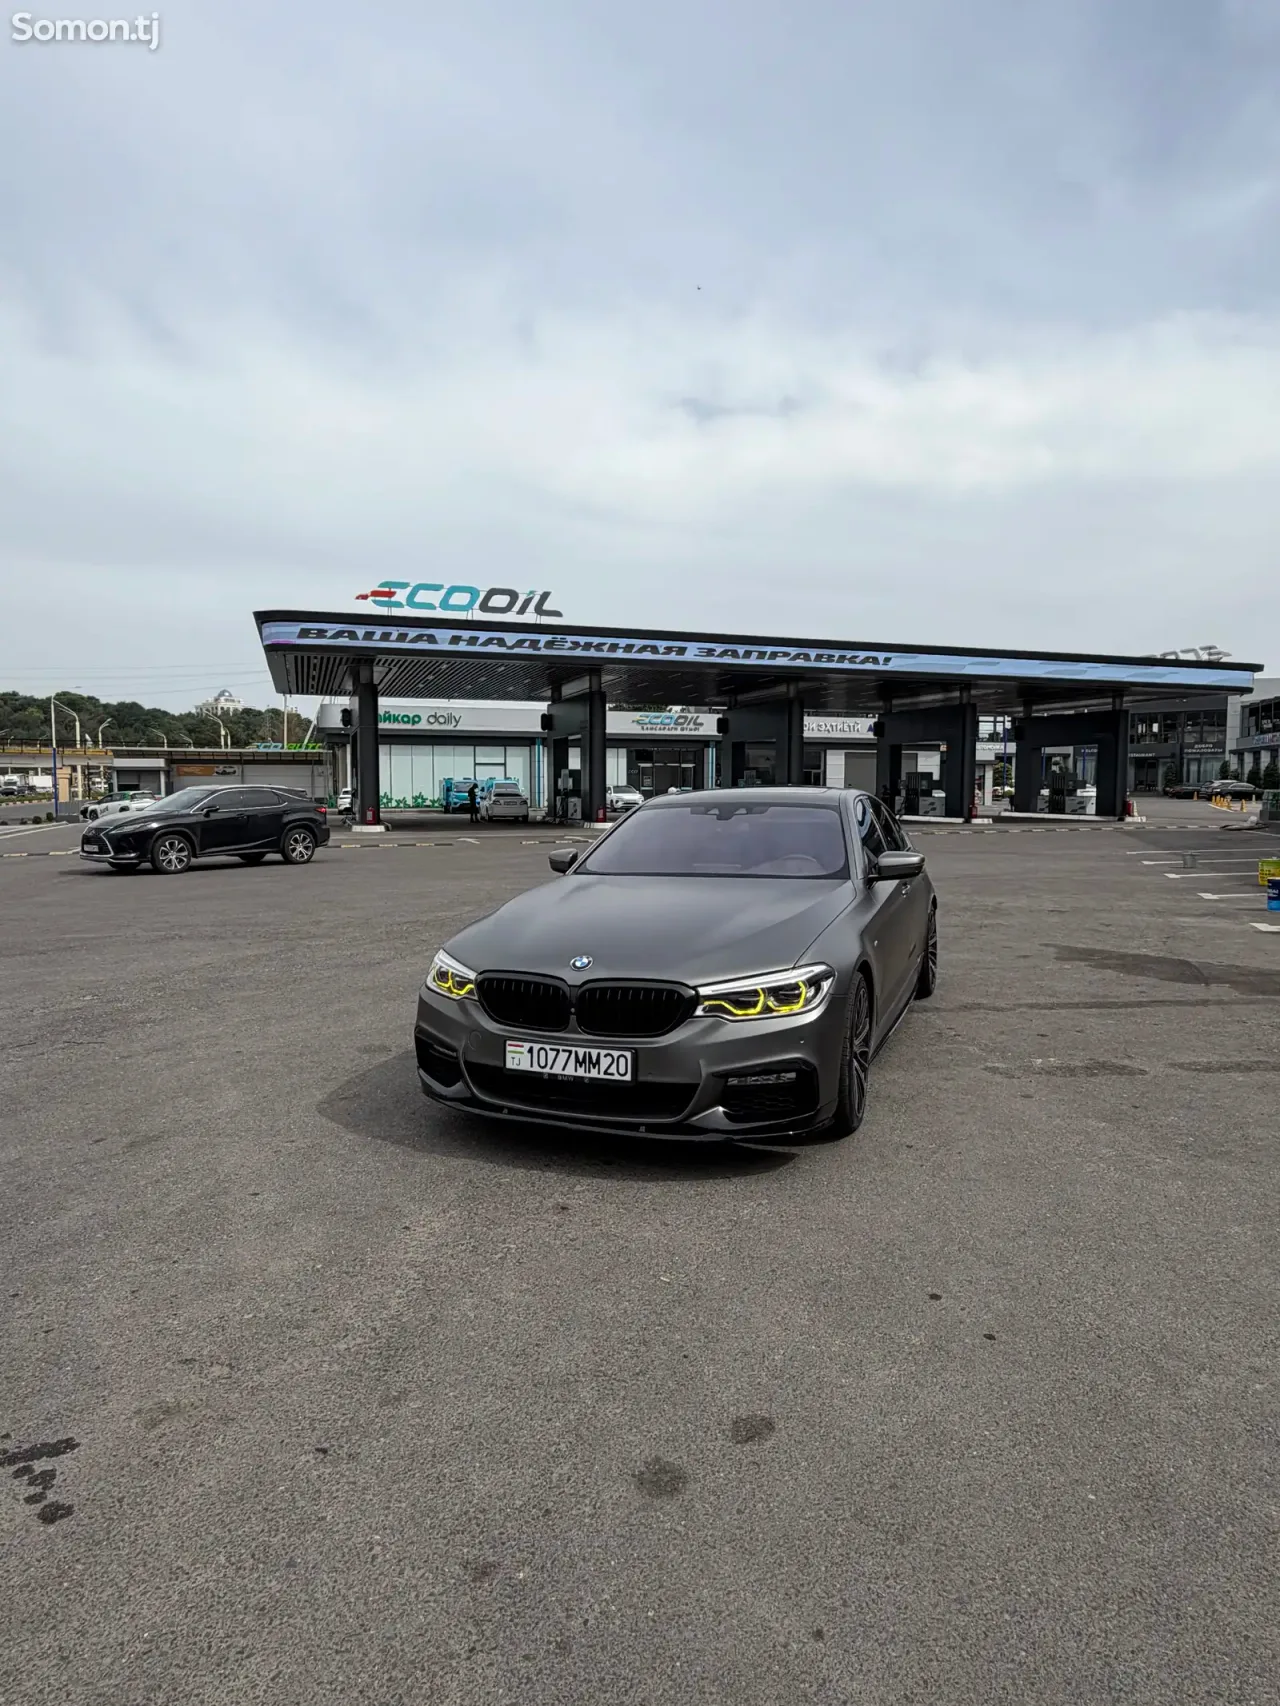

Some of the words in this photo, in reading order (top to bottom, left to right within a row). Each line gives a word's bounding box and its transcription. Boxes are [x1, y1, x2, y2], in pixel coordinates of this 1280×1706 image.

[296, 627, 440, 646] ВАША
[447, 634, 689, 657] НАДЁЖНАЯ
[693, 646, 893, 666] ЗАПРАВКА!
[426, 711, 462, 728] daily
[510, 1056, 521, 1067] TJ
[526, 1045, 629, 1078] 1077MM20
